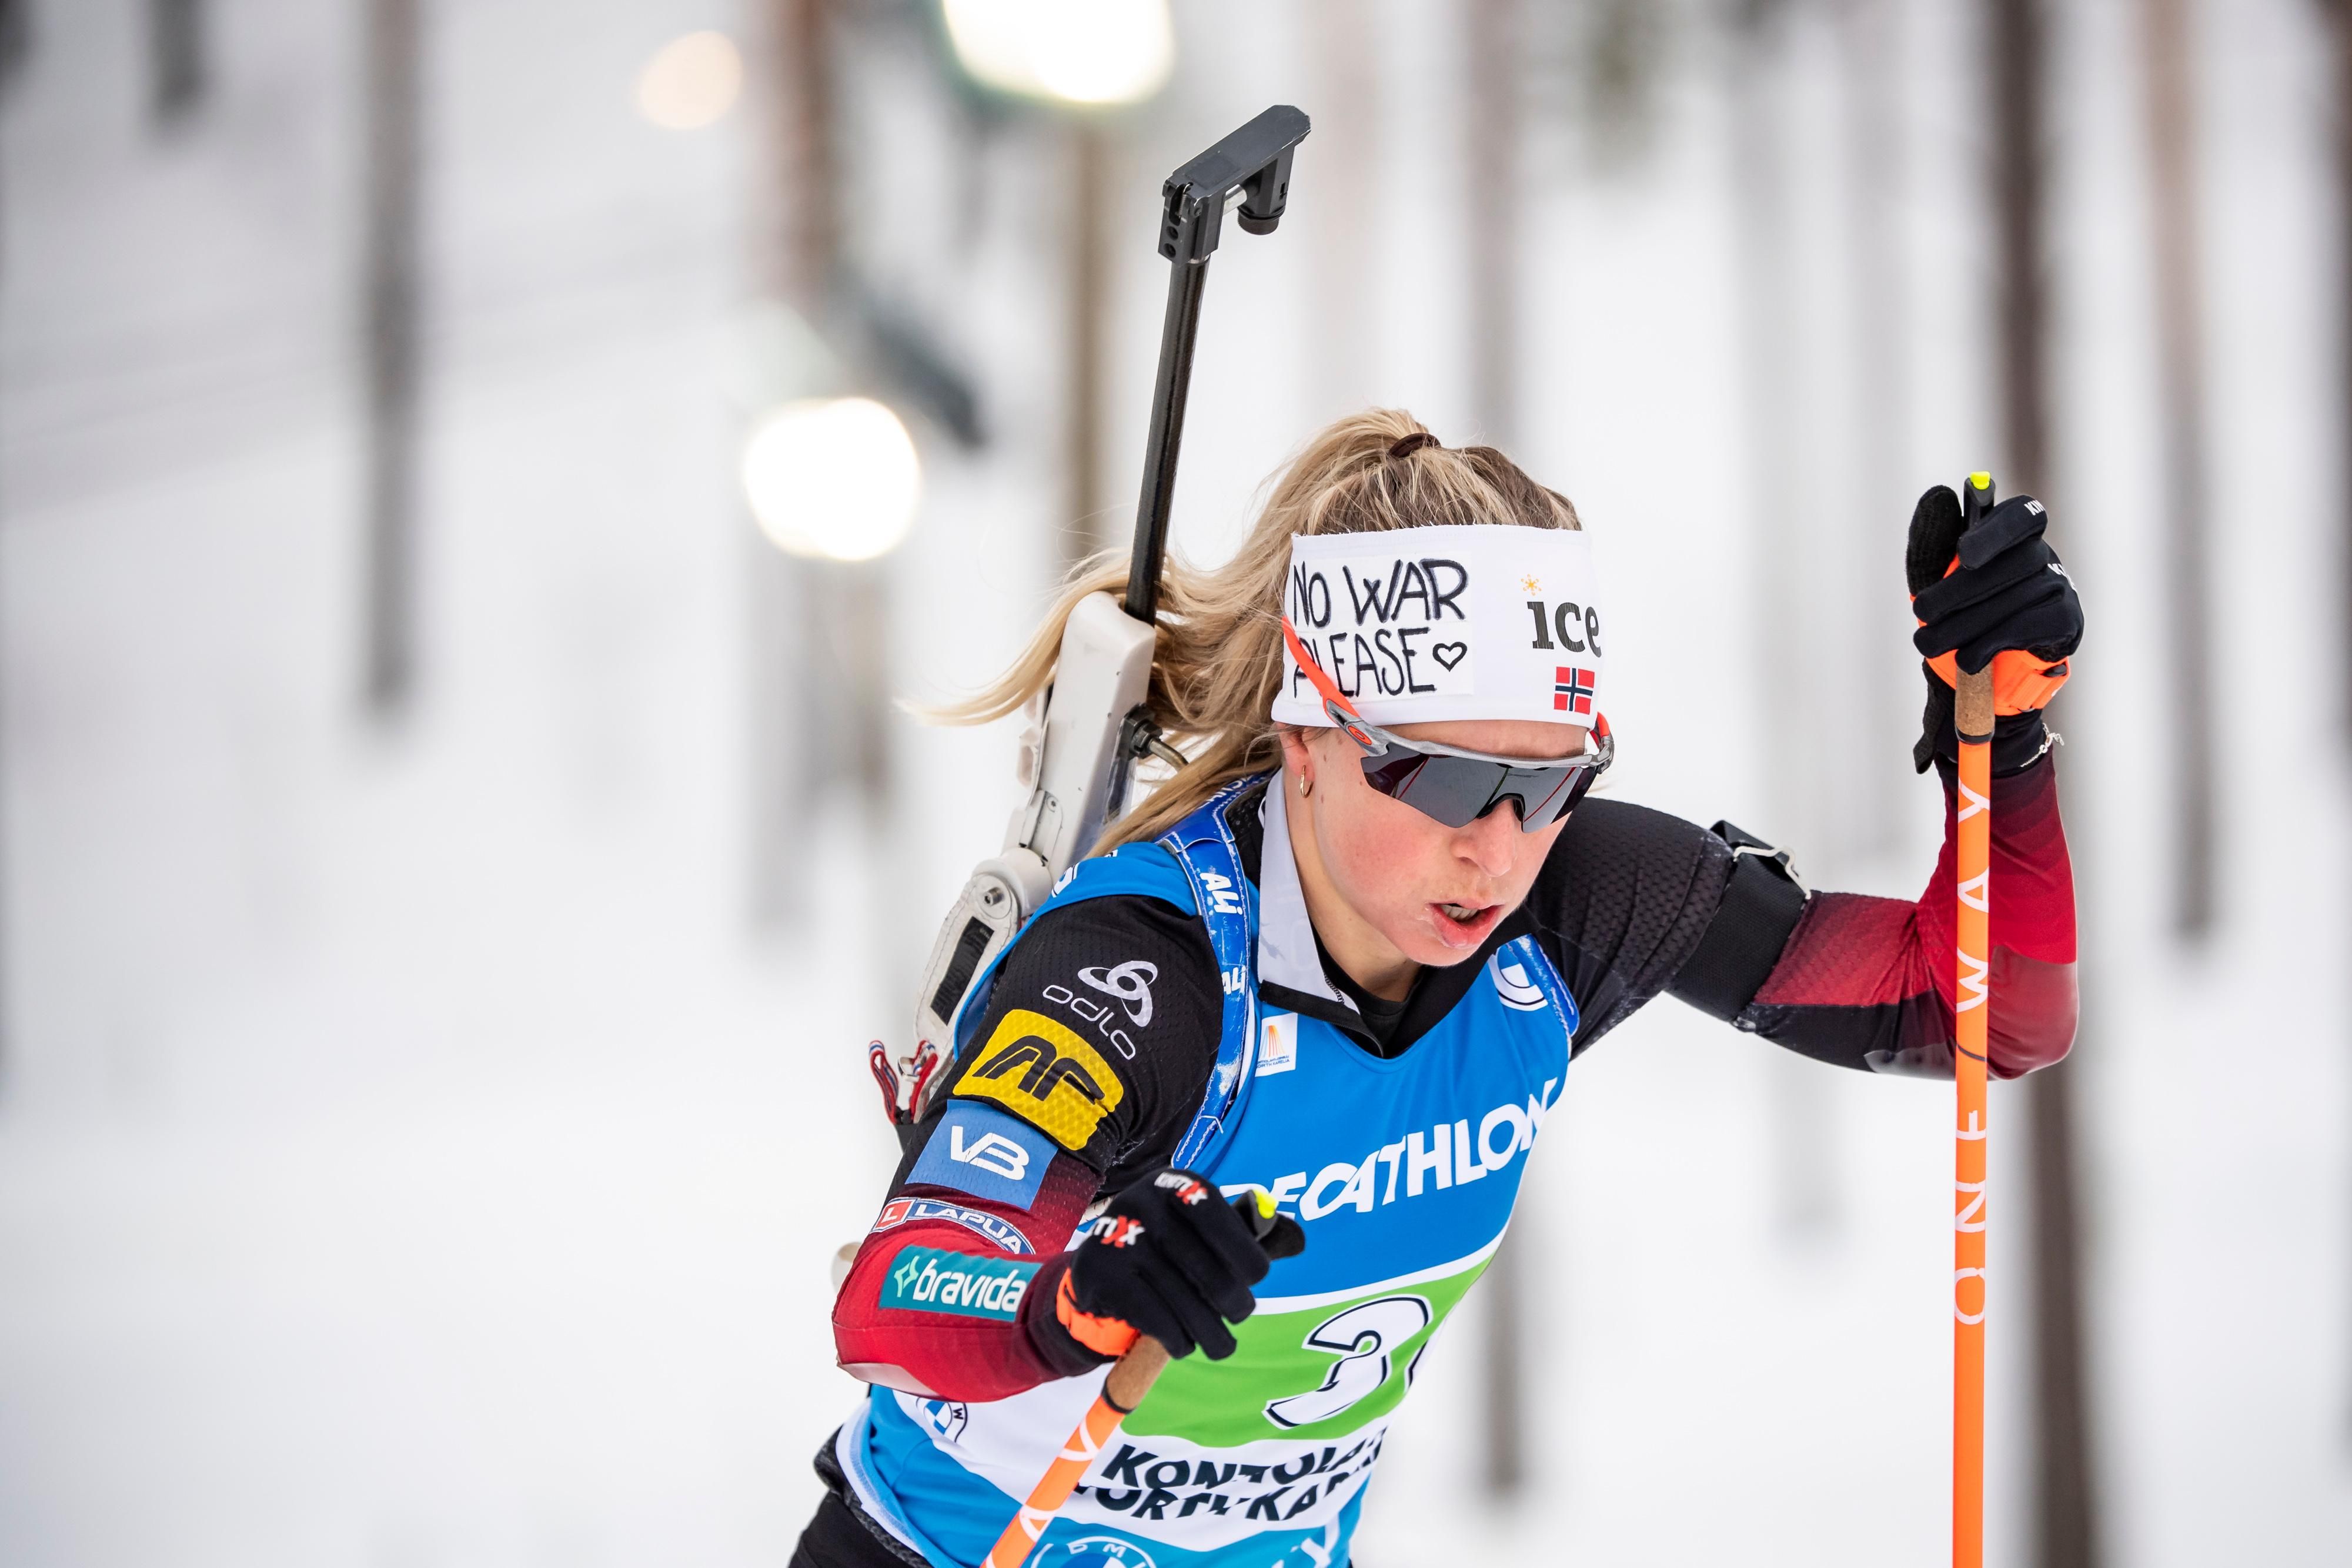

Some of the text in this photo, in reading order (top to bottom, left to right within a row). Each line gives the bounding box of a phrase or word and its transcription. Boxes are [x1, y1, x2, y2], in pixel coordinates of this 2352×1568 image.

[1294, 559, 1468, 628] NO WAR
[1526, 601, 1602, 658] ice
[1956, 779, 1991, 1013] WAY
[950, 1126, 1030, 1181] VB
[914, 1204, 1023, 1255] LAPUA
[913, 1258, 1028, 1312] bravida
[1262, 1293, 1442, 1430] 3
